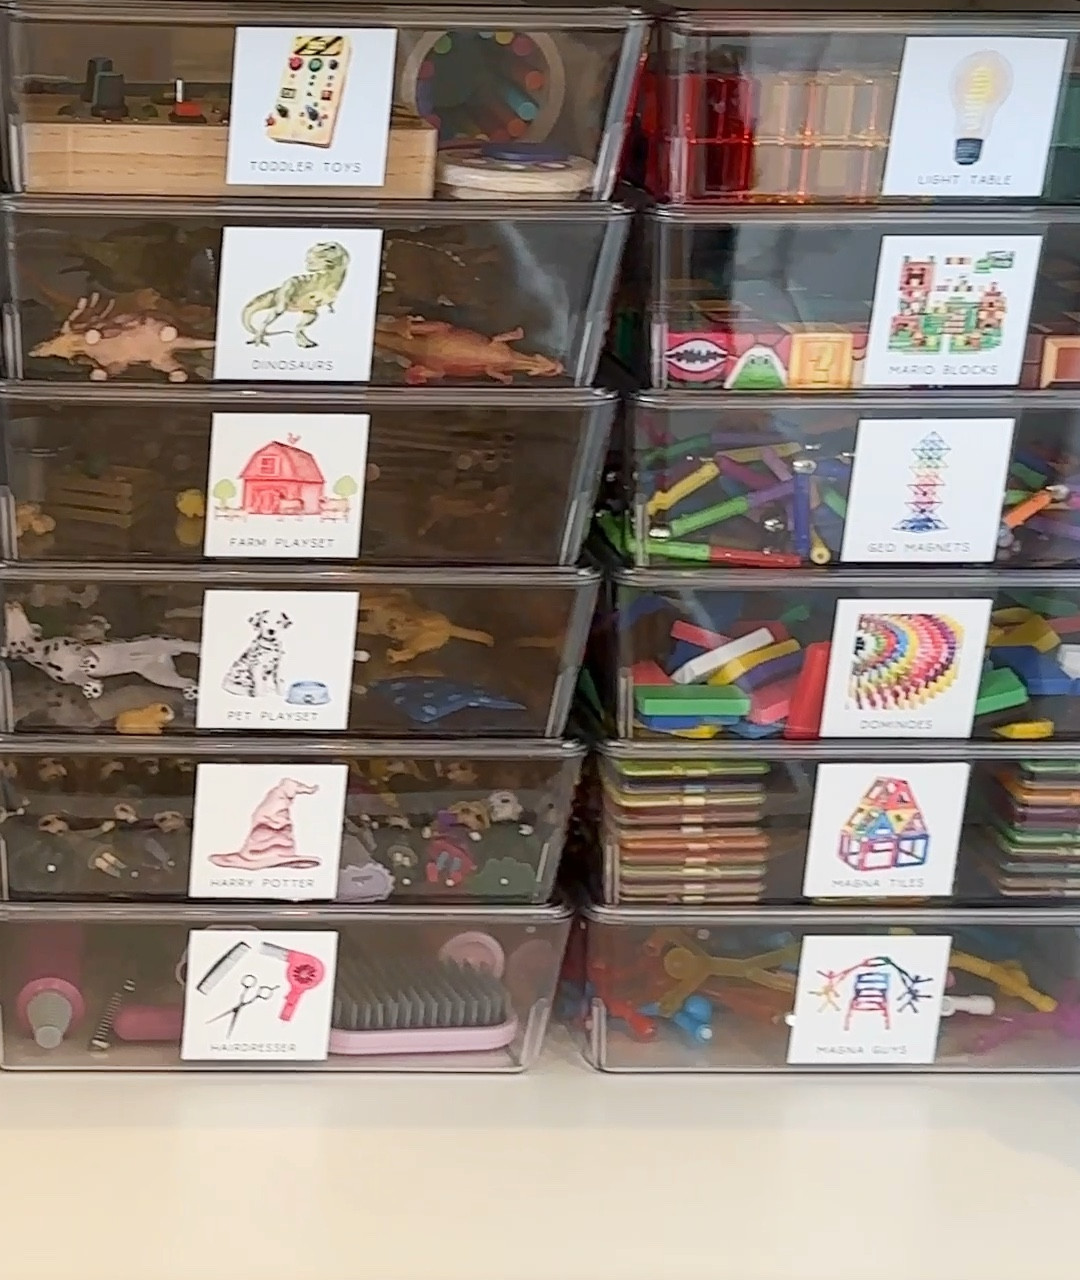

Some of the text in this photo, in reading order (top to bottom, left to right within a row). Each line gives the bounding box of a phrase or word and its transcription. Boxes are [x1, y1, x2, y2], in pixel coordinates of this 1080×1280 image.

[250, 160, 362, 174] TODDLER TOYS
[917, 174, 1011, 186] LIGHT TABLE
[251, 359, 334, 371] DINOSAURS
[888, 364, 998, 376] MARIO BLOCKS
[229, 537, 335, 549] FARM PLAYSET
[866, 541, 971, 553] GEO MAGNETS
[226, 710, 319, 722] PET PLAYSET
[859, 719, 933, 730] DOMINOES
[209, 878, 315, 889] HARRY POTTER
[831, 877, 925, 889] MAGNA TILES
[210, 1042, 297, 1053] HAIRDRESSER
[815, 1044, 908, 1055] MAGNA GUYS
